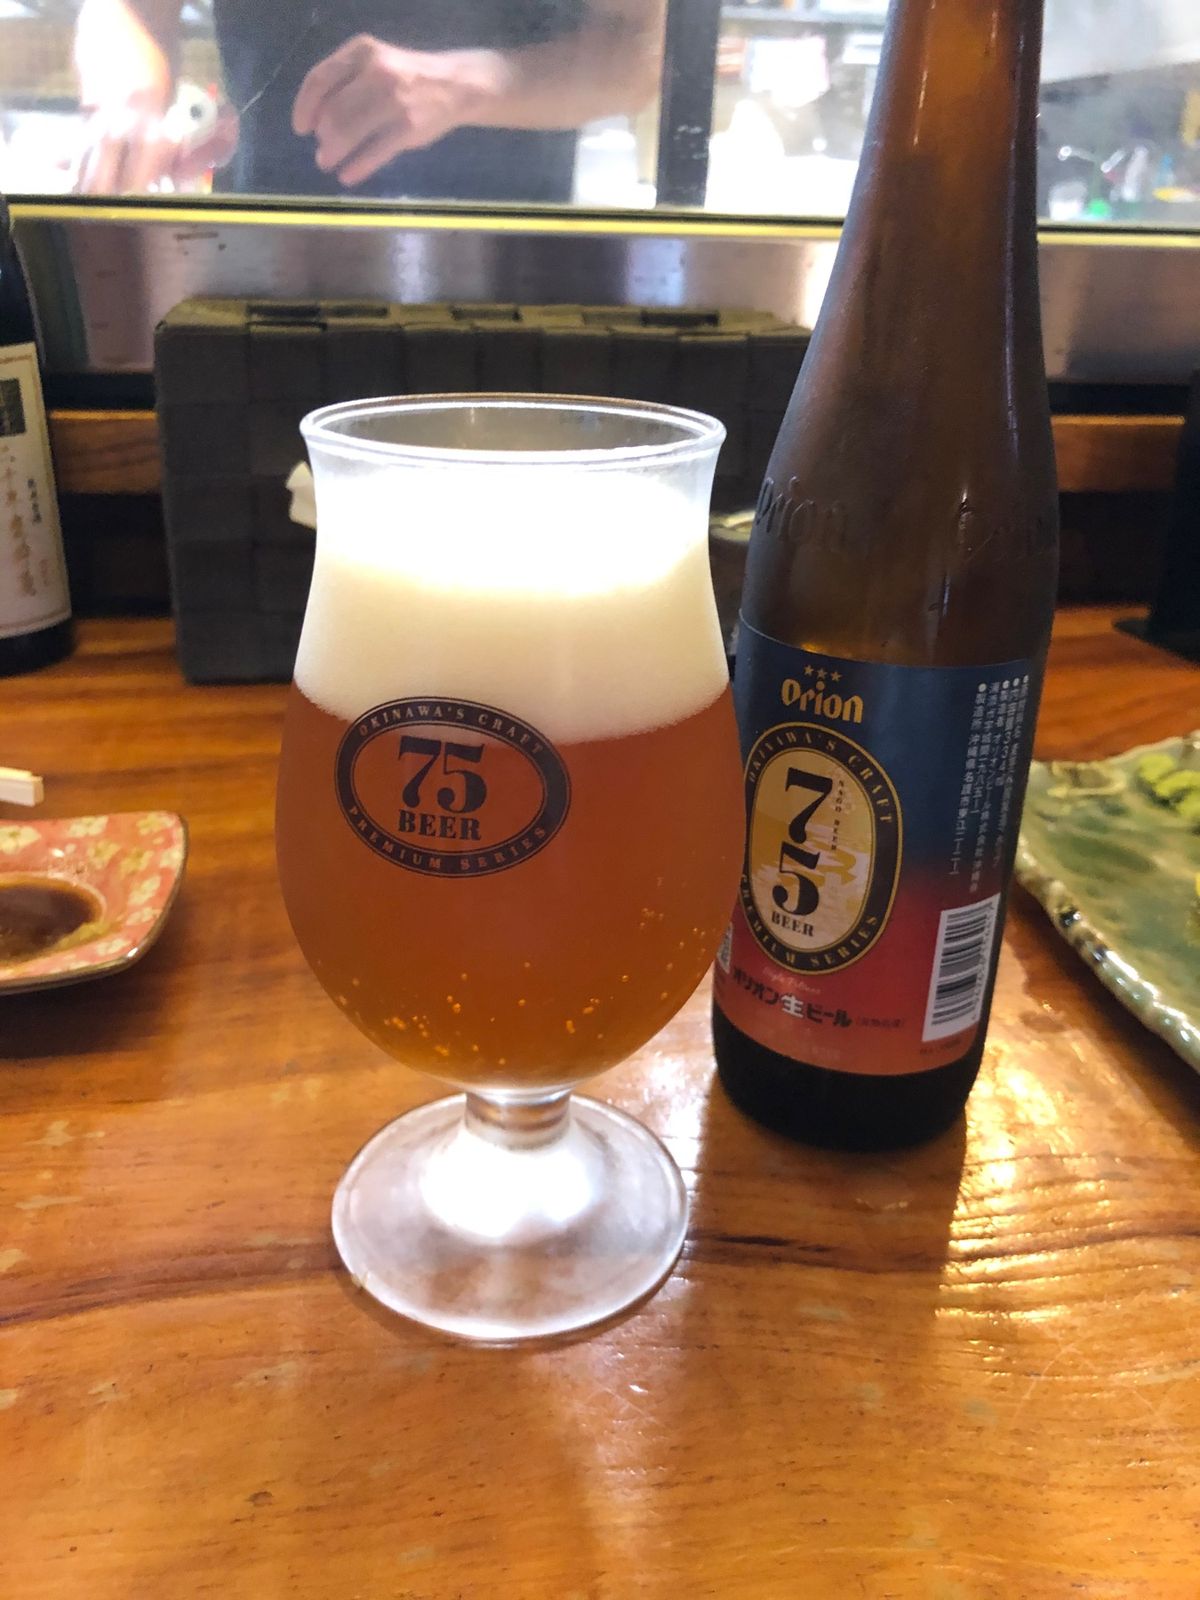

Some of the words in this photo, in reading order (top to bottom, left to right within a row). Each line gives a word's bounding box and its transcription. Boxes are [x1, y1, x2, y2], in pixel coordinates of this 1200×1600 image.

[781, 677, 864, 723] Orion
[359, 704, 465, 737] OKINAWA'S
[477, 712, 545, 755] CRAFT
[397, 735, 487, 814] 75
[847, 755, 893, 823] CRAFT
[348, 805, 443, 869] PREMIUM
[459, 826, 546, 870] SERIES
[397, 809, 482, 841] BEER
[771, 911, 815, 938] BEER
[810, 915, 878, 967] SERIES
